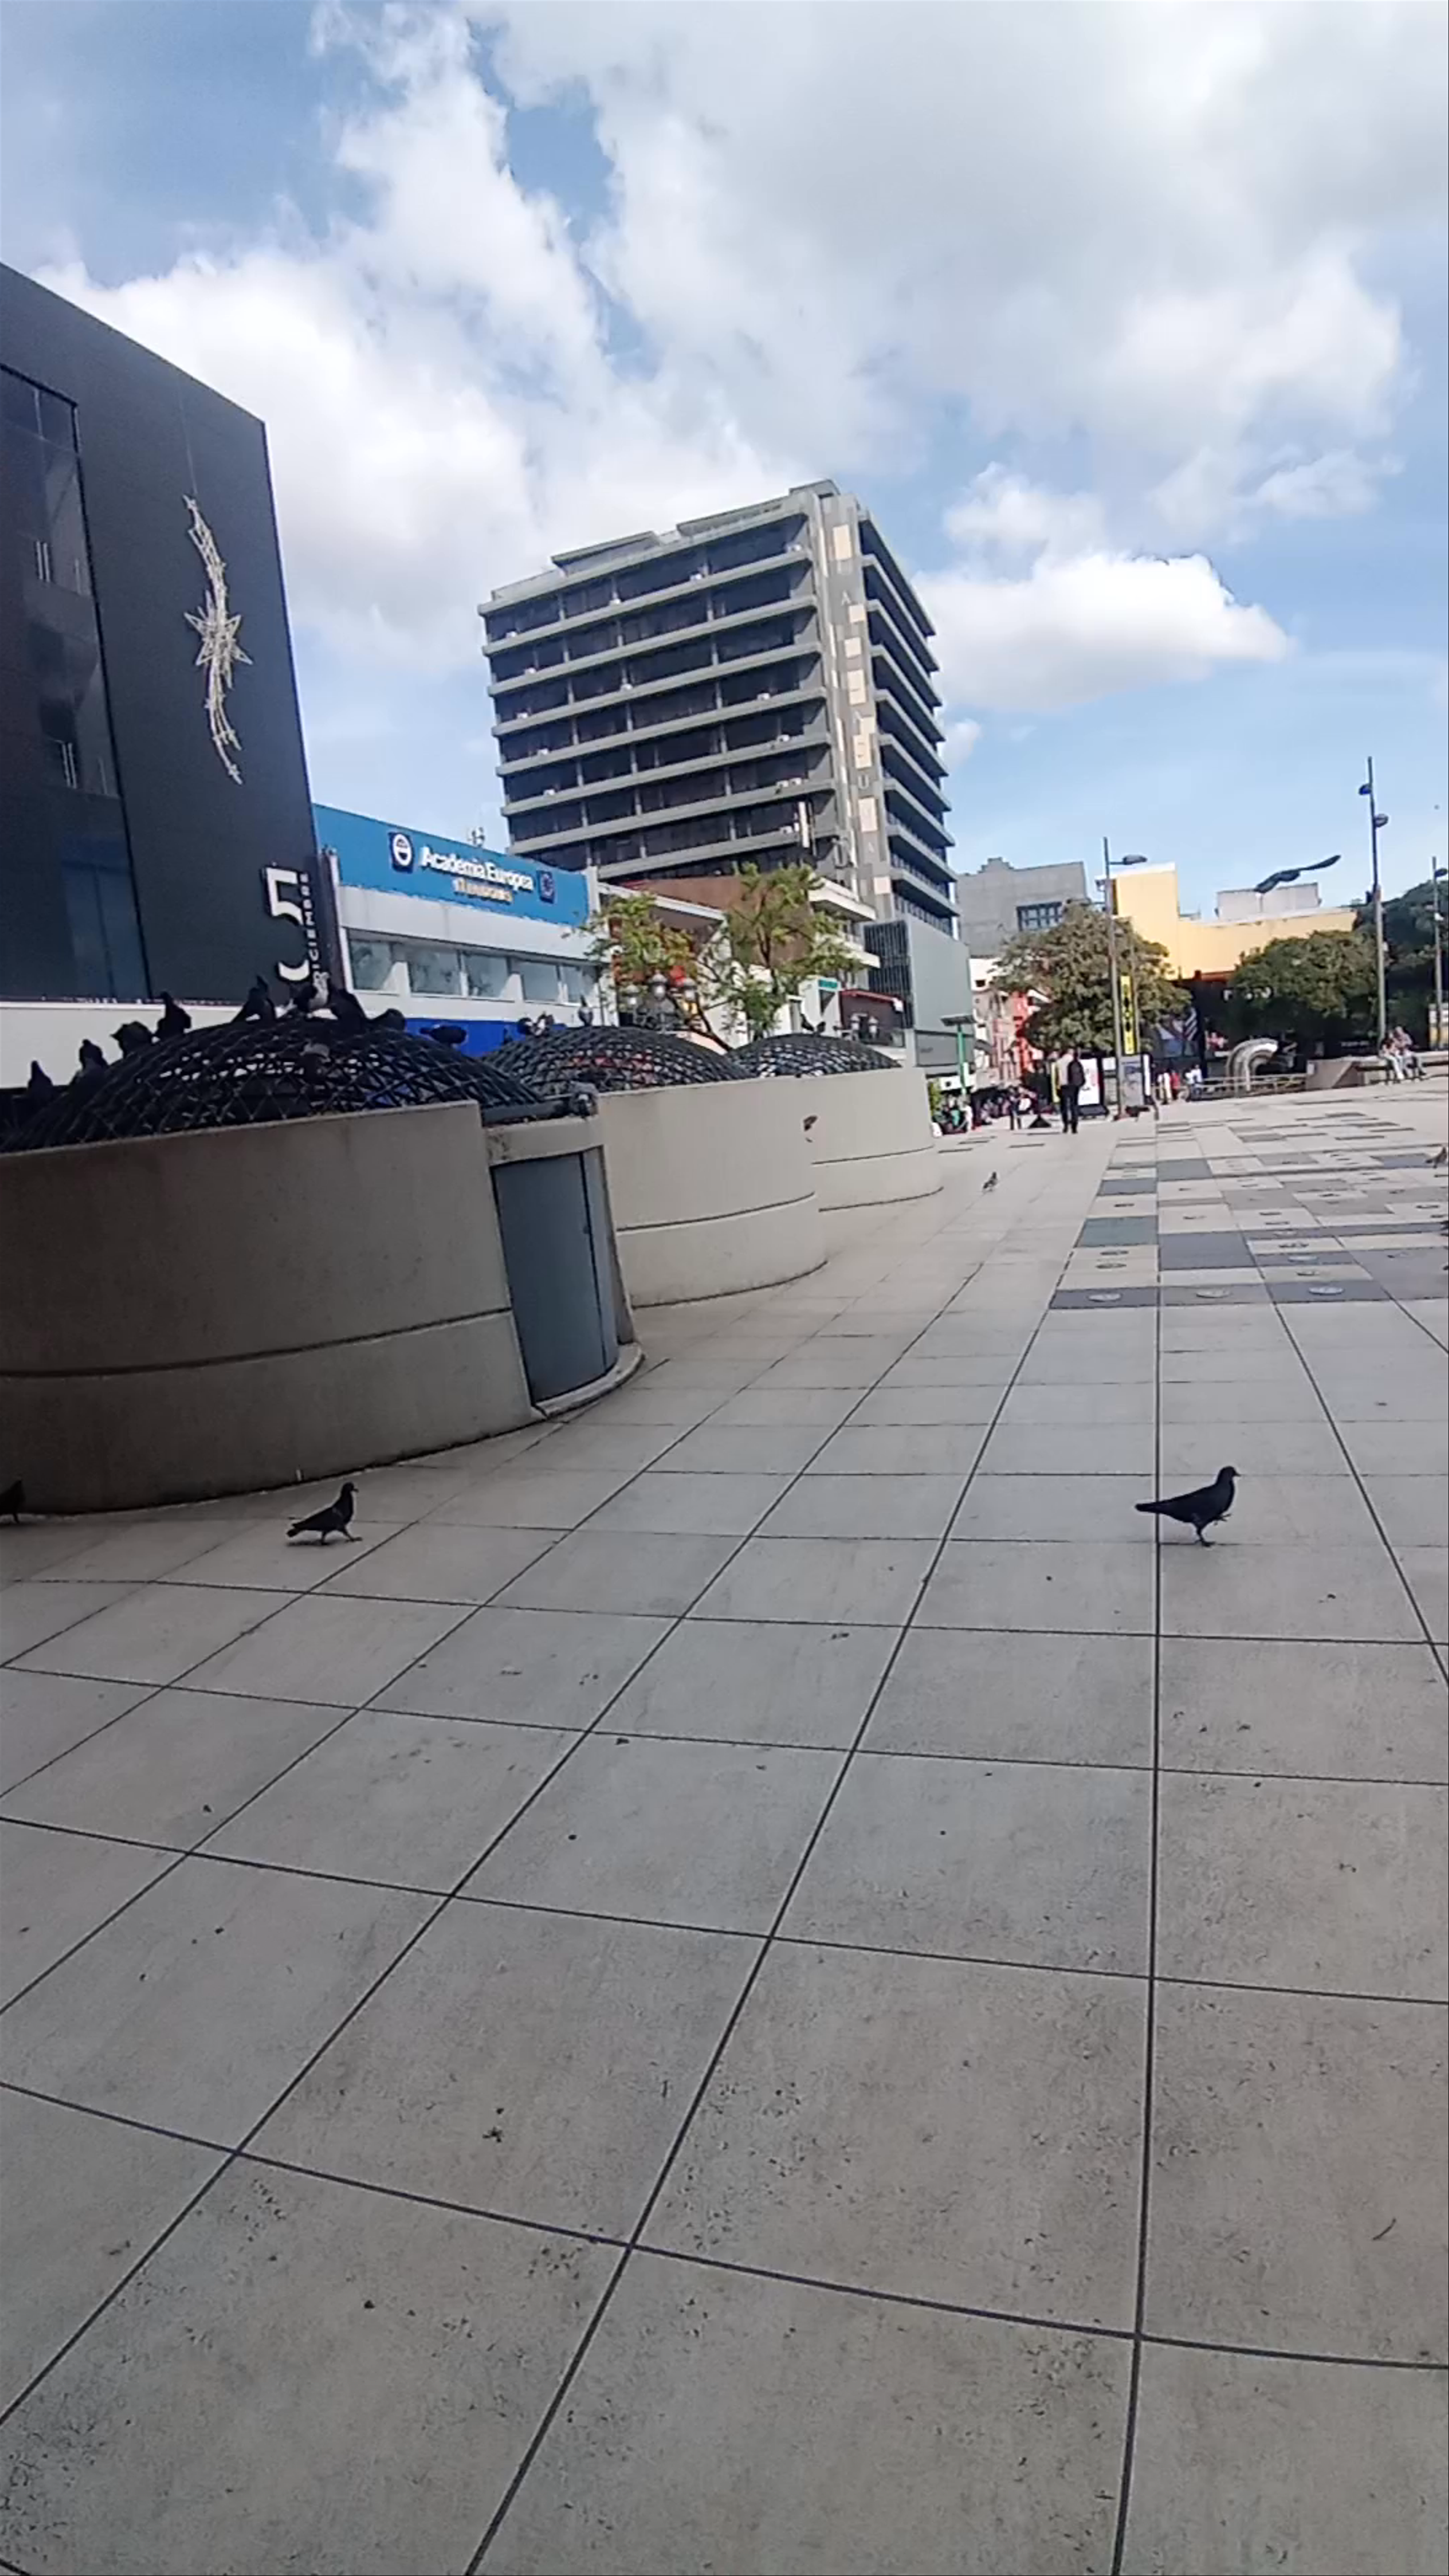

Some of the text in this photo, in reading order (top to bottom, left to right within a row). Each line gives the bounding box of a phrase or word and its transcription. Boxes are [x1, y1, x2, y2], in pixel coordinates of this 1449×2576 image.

[420, 846, 534, 891] Academia Europea
[266, 867, 310, 981] 5
